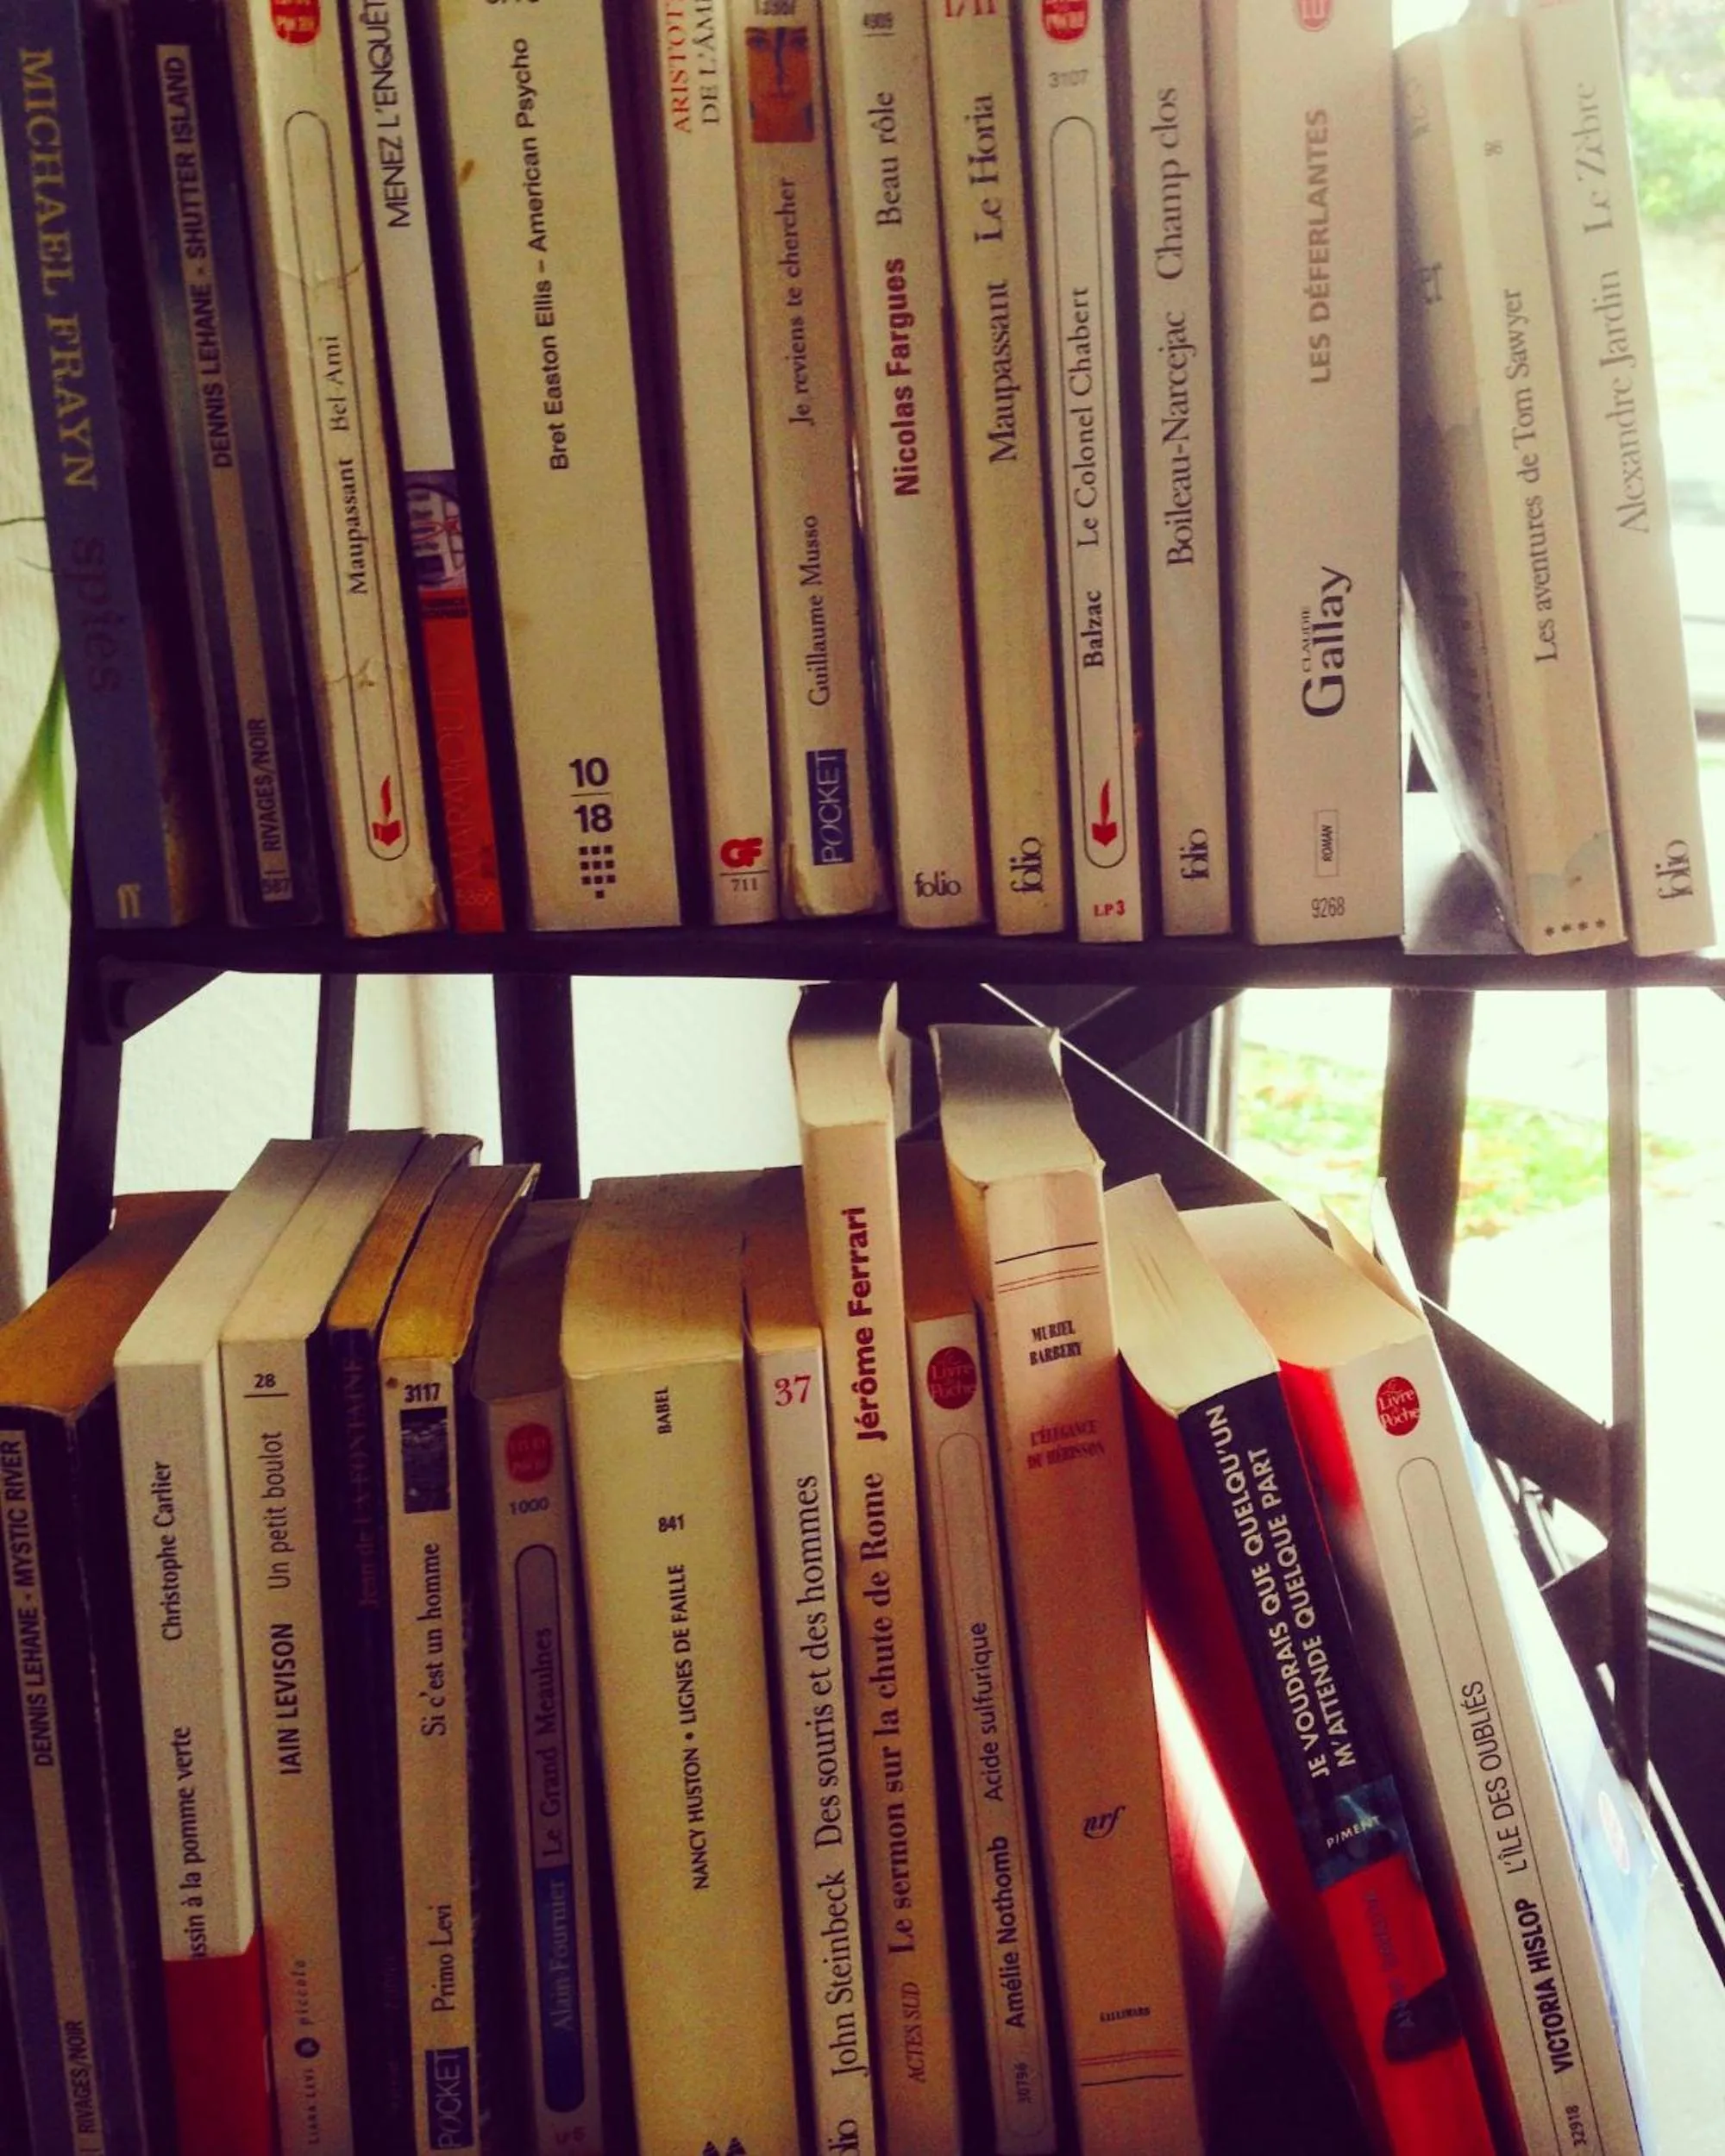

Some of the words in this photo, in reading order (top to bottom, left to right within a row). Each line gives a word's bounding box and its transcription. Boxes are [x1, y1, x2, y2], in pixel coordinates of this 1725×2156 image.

[360, 0, 400, 128] L'ENQUÊT
[509, 38, 538, 129] Psycho
[664, 0, 693, 133] ARISTOT
[165, 57, 198, 145] ISLAND
[699, 85, 720, 126] DE
[866, 92, 896, 145] rôle
[1151, 87, 1178, 150] clos
[1570, 83, 1609, 183] Zèbre
[19, 47, 76, 298] MICHAEL
[964, 93, 999, 184] Horla
[174, 152, 210, 260] SHUTTER
[378, 137, 411, 227] MENEZ
[521, 136, 549, 253] American
[876, 162, 903, 227] Beau
[1303, 109, 1331, 323] DÉFERLANTES
[1584, 191, 1614, 235] Le
[775, 176, 800, 279] chercher
[975, 198, 1005, 244] Le
[1154, 159, 1191, 279] Champ
[189, 285, 223, 377] LEHANE
[533, 277, 555, 328] Ellis
[786, 285, 803, 309] te
[885, 258, 916, 375] Fargues
[1590, 269, 1636, 369] Jardin
[784, 316, 810, 398] reviens
[1065, 286, 1095, 397] Chabert
[1310, 335, 1331, 385] LES
[1503, 288, 1532, 380] Sawyer
[46, 312, 97, 490] FRAYN
[323, 335, 350, 433] Bel-Ami
[538, 335, 564, 417] Easton
[988, 279, 1021, 464] Maupassant
[201, 382, 234, 468] DENNIS
[550, 423, 569, 470] Bret
[789, 402, 814, 427] Je
[890, 384, 920, 497] Nicolas
[1157, 311, 1197, 567] Boileau-Narcejac
[1512, 386, 1540, 447] Tom
[1064, 406, 1097, 510] Colonel
[1517, 452, 1540, 484] de
[1603, 376, 1650, 533] Alexandre
[342, 458, 369, 595] Maupassant
[800, 515, 819, 587] Musso
[1076, 517, 1099, 548] Le
[1528, 495, 1559, 612] aventures
[806, 594, 831, 706] Guillaume
[1079, 590, 1105, 668] Balzac
[1302, 565, 1352, 718] Gallay
[1534, 619, 1559, 665] Les
[248, 718, 283, 852] RIVAGES/NOIR
[568, 757, 609, 788] 10
[813, 749, 844, 863] POCKET
[574, 804, 613, 833] 18
[1320, 824, 1333, 862] ROMAN
[731, 878, 758, 892] 711
[914, 872, 961, 897] folio
[1010, 837, 1044, 893] folio
[1181, 829, 1209, 881] folio
[1654, 839, 1694, 900] folio
[1311, 895, 1346, 918] 9268
[841, 1206, 872, 1317] Ferrari
[1029, 1342, 1082, 1366] BARBERY
[1032, 1320, 1076, 1342] MURIEL
[254, 1373, 277, 1388] 28
[404, 1383, 440, 1402] 3117
[655, 1386, 672, 1434] BABEL
[774, 1376, 811, 1407] 37
[851, 1327, 888, 1442] Jérôme
[0, 1440, 28, 1501] RIVER
[149, 1461, 174, 1527] Carlier
[258, 1431, 285, 1498] boulot
[1205, 1404, 1264, 1556] QUELQU'UN
[1248, 1448, 1283, 1506] PART
[7, 1510, 36, 1588] MYSTIC
[261, 1506, 296, 1556] petit
[658, 1515, 685, 1532] 841
[796, 1475, 826, 1606] hommes
[859, 1473, 888, 1564] Rome
[154, 1532, 185, 1642] Christophe
[267, 1563, 292, 1591] Un
[417, 1543, 443, 1622] homme
[668, 1564, 687, 1622] FAILLE
[863, 1571, 891, 1608] de
[1251, 1563, 1282, 1616] QUE
[1267, 1514, 1316, 1628] QUELQUE
[17, 1606, 45, 1687] LEHANE
[271, 1622, 299, 1719] LEVISON
[428, 1628, 443, 1652] un
[674, 1628, 691, 1654] DE
[800, 1612, 831, 1664] des
[869, 1616, 899, 1700] chute
[420, 1657, 445, 1705] c'est
[532, 1627, 560, 1739] Meaulnes
[677, 1658, 697, 1726] LIGNES
[811, 1667, 831, 1695] et
[970, 1621, 998, 1736] sulfurique
[1268, 1622, 1319, 1752] VOUDRAIS
[1302, 1635, 1356, 1770] M'ATTENDE
[26, 1692, 53, 1768] DENNIS
[171, 1727, 195, 1781] verte
[273, 1727, 302, 1775] IAIN
[422, 1713, 446, 1737] Si
[805, 1702, 839, 1787] souris
[873, 1708, 900, 1740] la
[1461, 1678, 1503, 1772] OUBLIÉS
[536, 1745, 561, 1822] Grand
[682, 1748, 705, 1823] HUSTON
[883, 1745, 904, 1793] sur
[978, 1740, 1004, 1802] Acide
[1307, 1752, 1331, 1779] JE
[1485, 1777, 1515, 1821] DES
[177, 1788, 206, 1865] pomme
[543, 1828, 562, 1857] Le
[814, 1796, 842, 1850] Des
[1082, 1806, 1127, 1839] nrf
[1325, 1814, 1382, 1849] PIMENT
[1496, 1826, 1529, 1876] L'ÎLE
[179, 1871, 202, 1894] la
[690, 1829, 709, 1890] NANCY
[887, 1802, 911, 1912] sermon
[985, 1835, 1018, 1946] Nothomb
[180, 1896, 204, 1908] à
[429, 1903, 454, 1948] Levi
[818, 1868, 854, 2003] Steinbeck
[888, 1919, 915, 1955] Le
[1515, 1898, 1552, 1975] HISLOP
[290, 1959, 315, 2026] piccolo
[431, 1952, 455, 2012] Primo
[901, 1981, 922, 2018] SUD
[994, 1951, 1026, 2029] Amélie
[831, 2010, 868, 2080] John
[907, 2022, 925, 2084] ACTES
[1533, 1977, 1574, 2074] VICTORIA
[65, 2019, 97, 2134] RIVAGES/NOIR
[439, 2050, 461, 2149] POCKET
